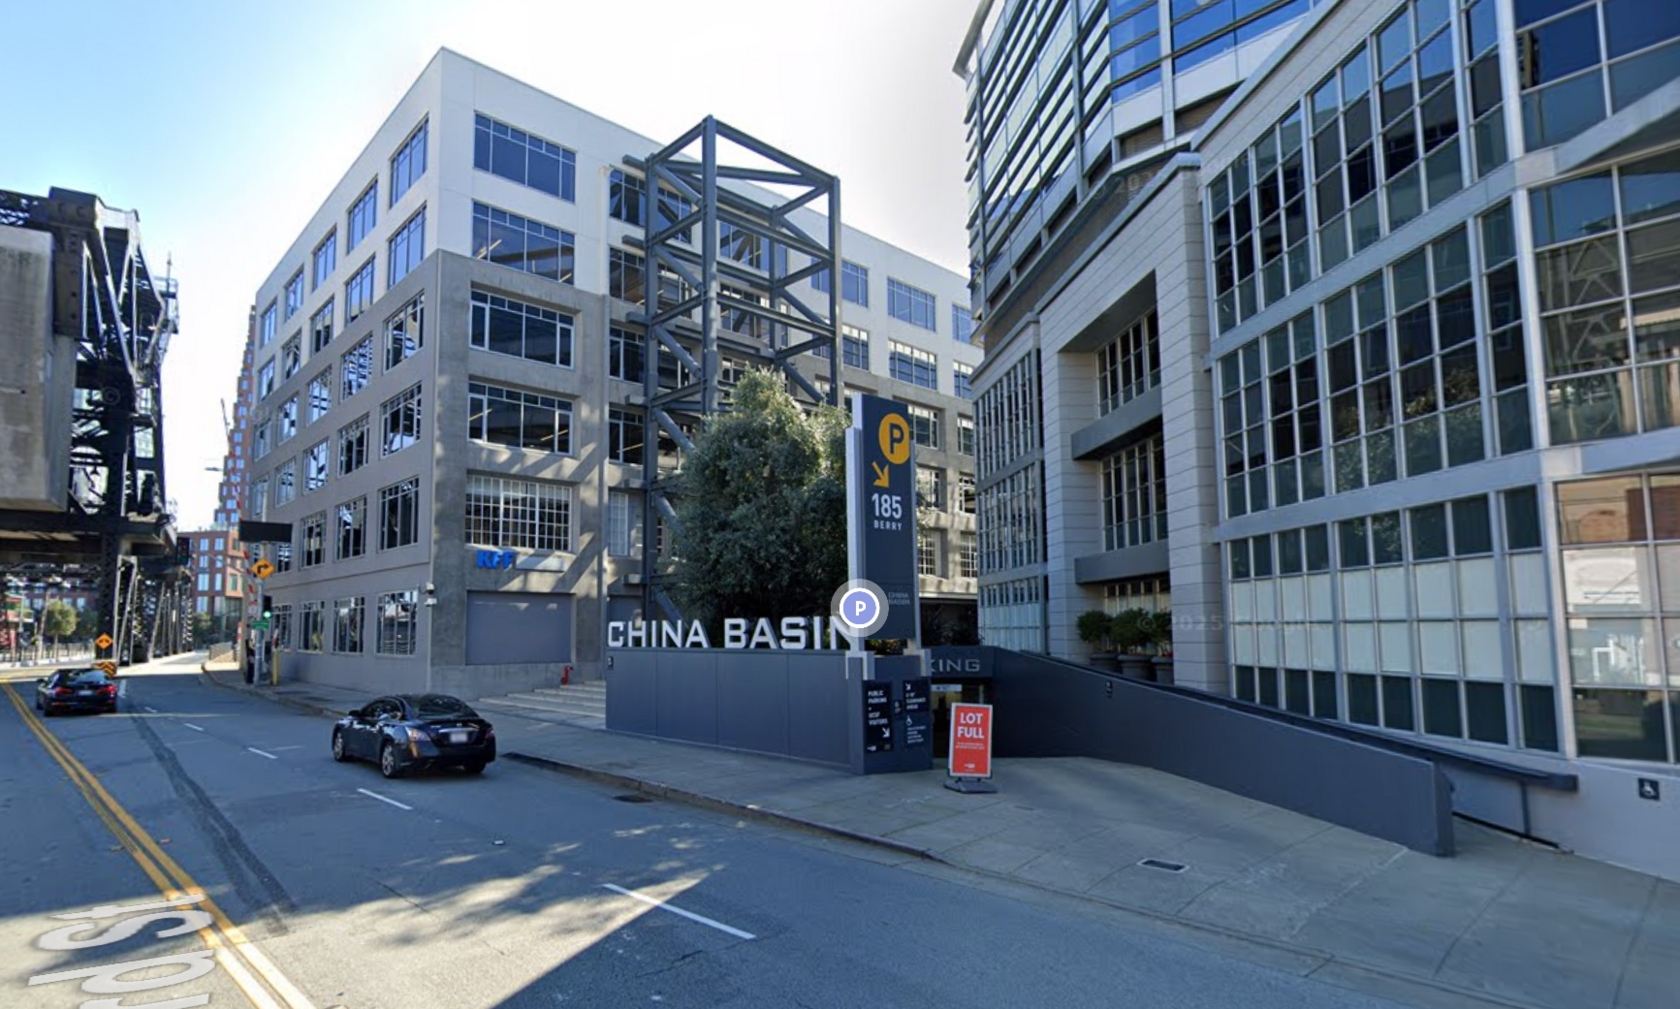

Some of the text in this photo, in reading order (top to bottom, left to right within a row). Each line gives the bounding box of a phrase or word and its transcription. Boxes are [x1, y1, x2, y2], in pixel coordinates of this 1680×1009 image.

[889, 422, 904, 455] P
[871, 493, 902, 519] 185
[873, 519, 903, 531] BERRY
[476, 549, 514, 569] KFF
[608, 618, 710, 648] CHINA
[960, 711, 983, 724] LOT
[957, 725, 985, 739] FULL
